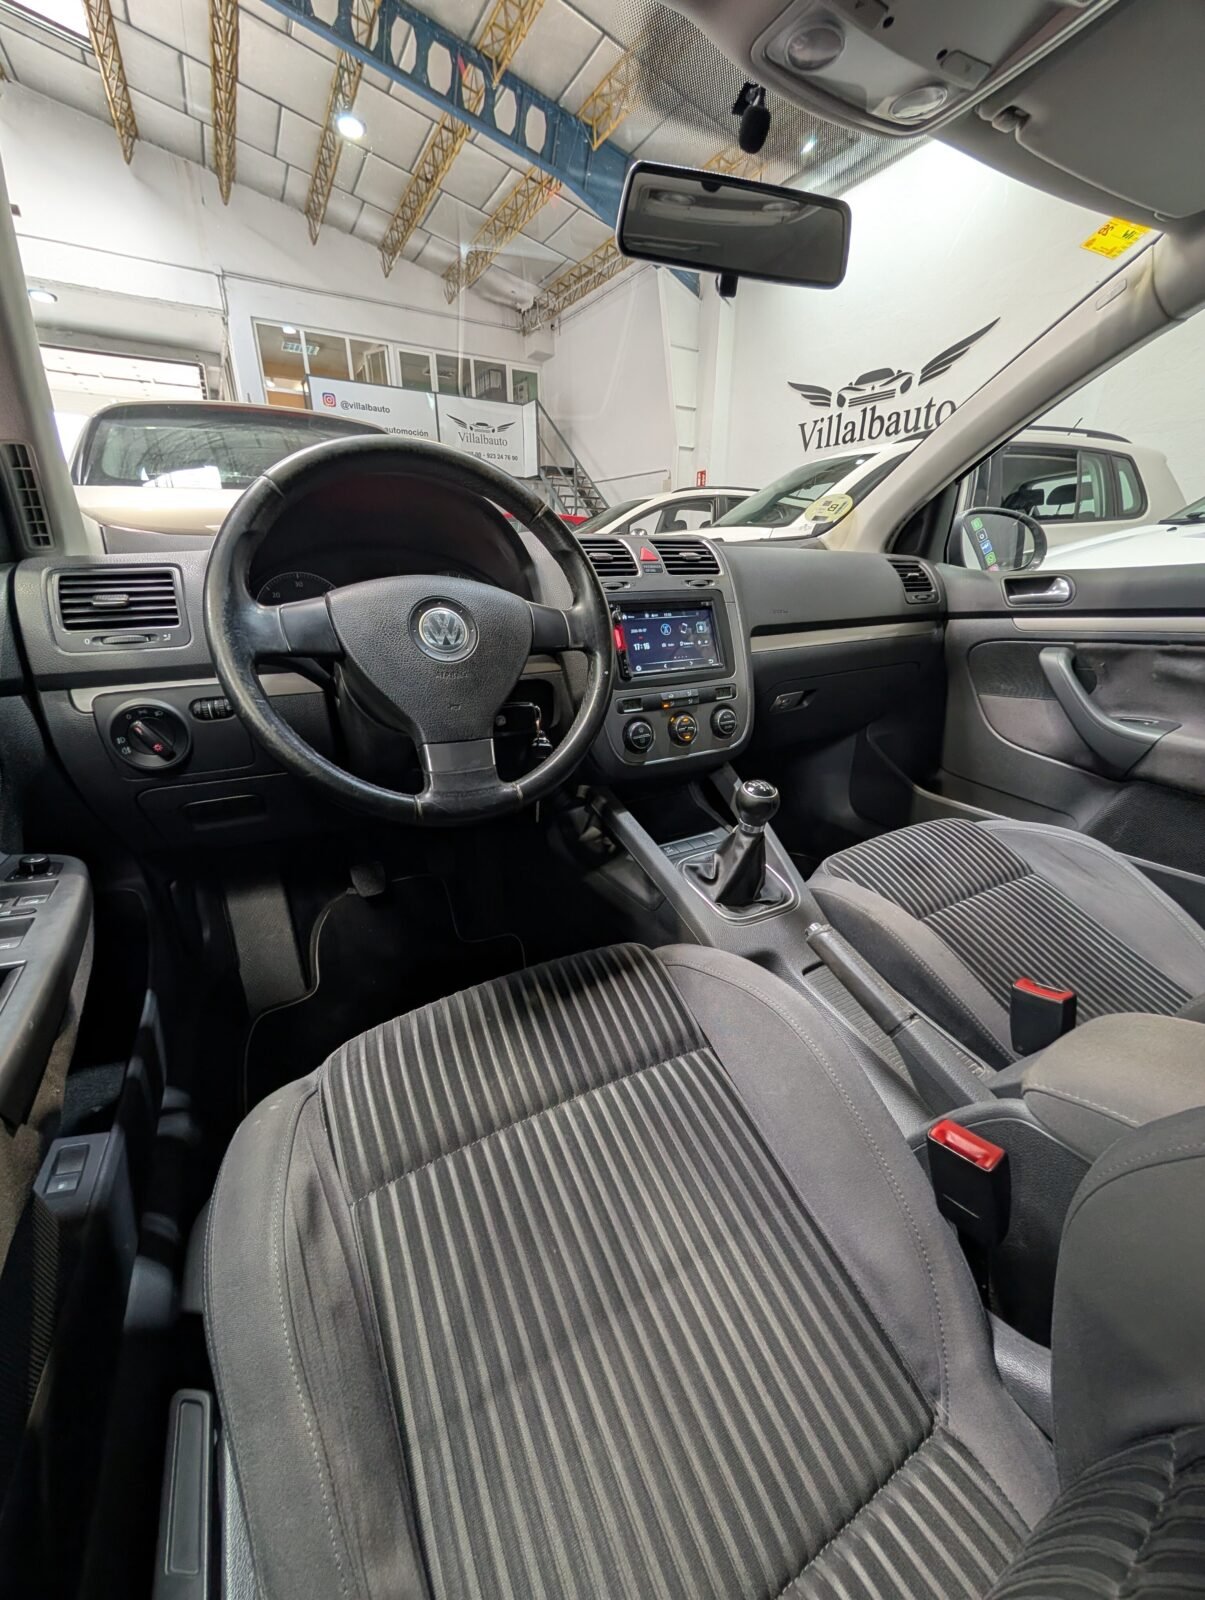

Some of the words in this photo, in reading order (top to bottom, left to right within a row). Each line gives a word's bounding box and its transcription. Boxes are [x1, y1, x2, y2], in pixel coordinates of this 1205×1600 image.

[340, 400, 391, 414] @villalbauto
[799, 397, 957, 452] Villalbauto
[458, 432, 508, 446] Villalbauto
